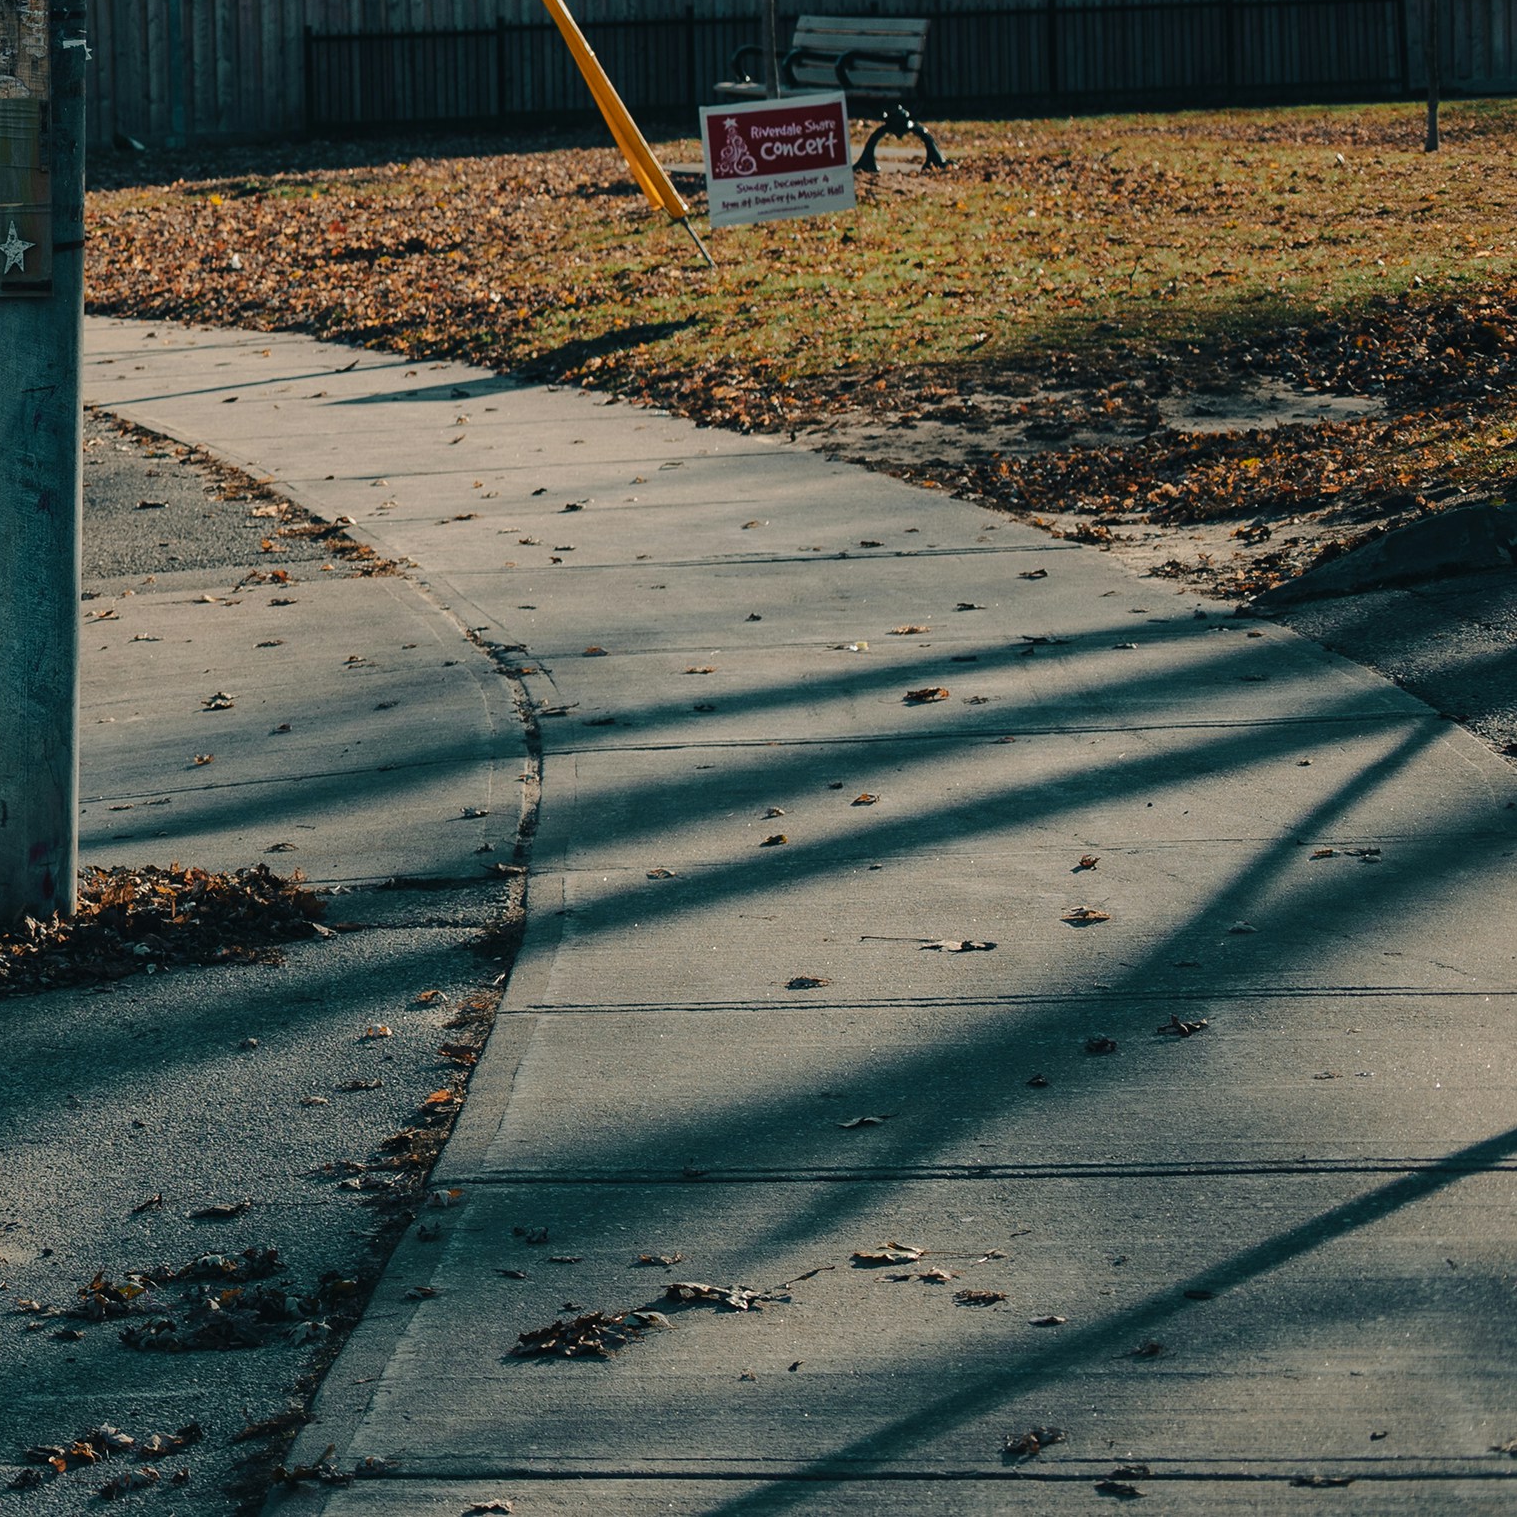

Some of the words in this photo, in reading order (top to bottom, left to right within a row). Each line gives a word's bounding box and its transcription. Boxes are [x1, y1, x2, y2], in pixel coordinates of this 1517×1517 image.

[750, 122, 803, 139] Riverdale
[805, 119, 836, 133] Share
[773, 176, 819, 188] December
[798, 188, 824, 199] Music
[827, 185, 845, 195] Hall
